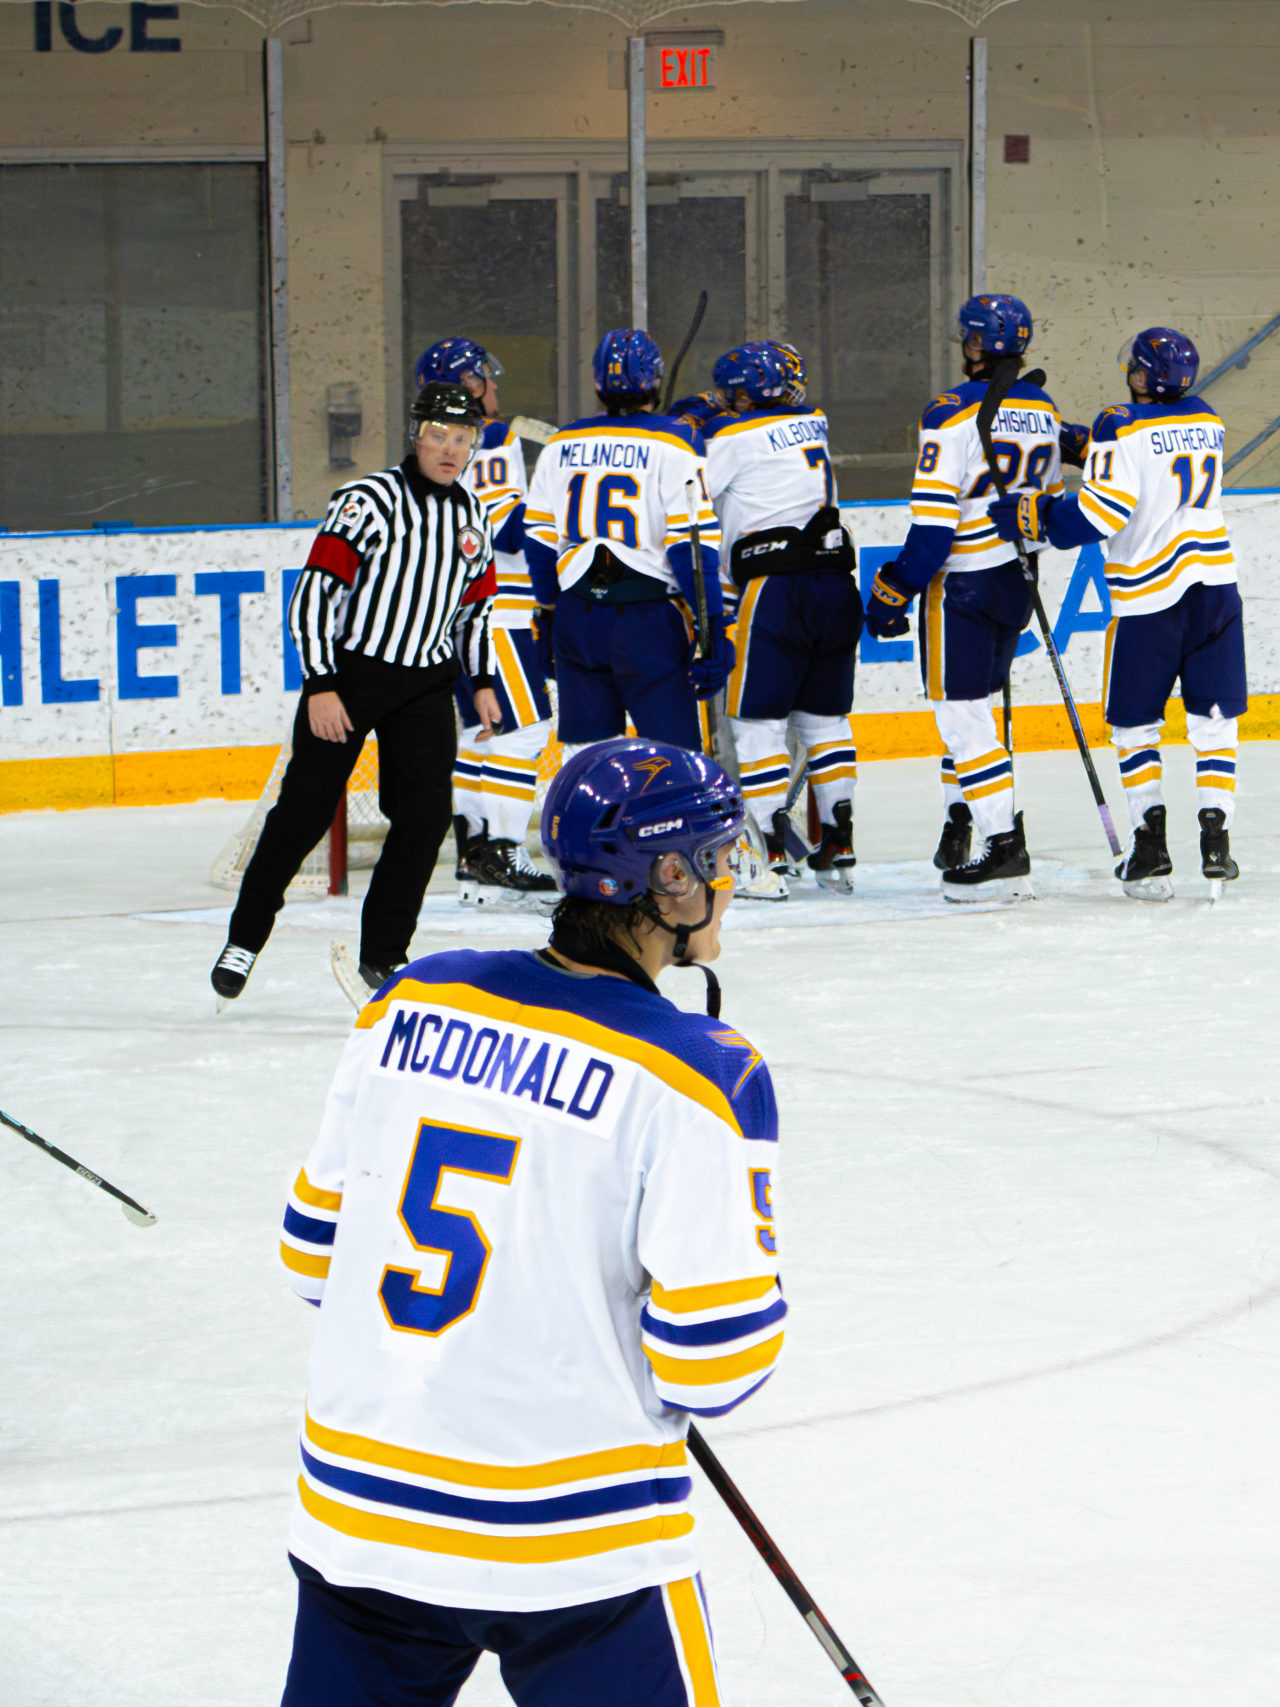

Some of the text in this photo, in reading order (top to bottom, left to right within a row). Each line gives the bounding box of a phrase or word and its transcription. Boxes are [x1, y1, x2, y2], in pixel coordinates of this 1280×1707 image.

[34, 1, 182, 53] ICE
[660, 48, 711, 87] EXIT
[473, 456, 508, 491] 10
[559, 443, 650, 469] MELANCON
[801, 445, 837, 509] 7
[918, 441, 941, 474] 8
[1089, 449, 1114, 483] 11
[1170, 453, 1217, 510] 11
[561, 471, 641, 550] 16
[740, 540, 788, 559] CCM
[0, 570, 304, 706] LET
[638, 818, 684, 838] CCM
[379, 1008, 615, 1121] MCDONALD
[378, 1117, 522, 1338] 5
